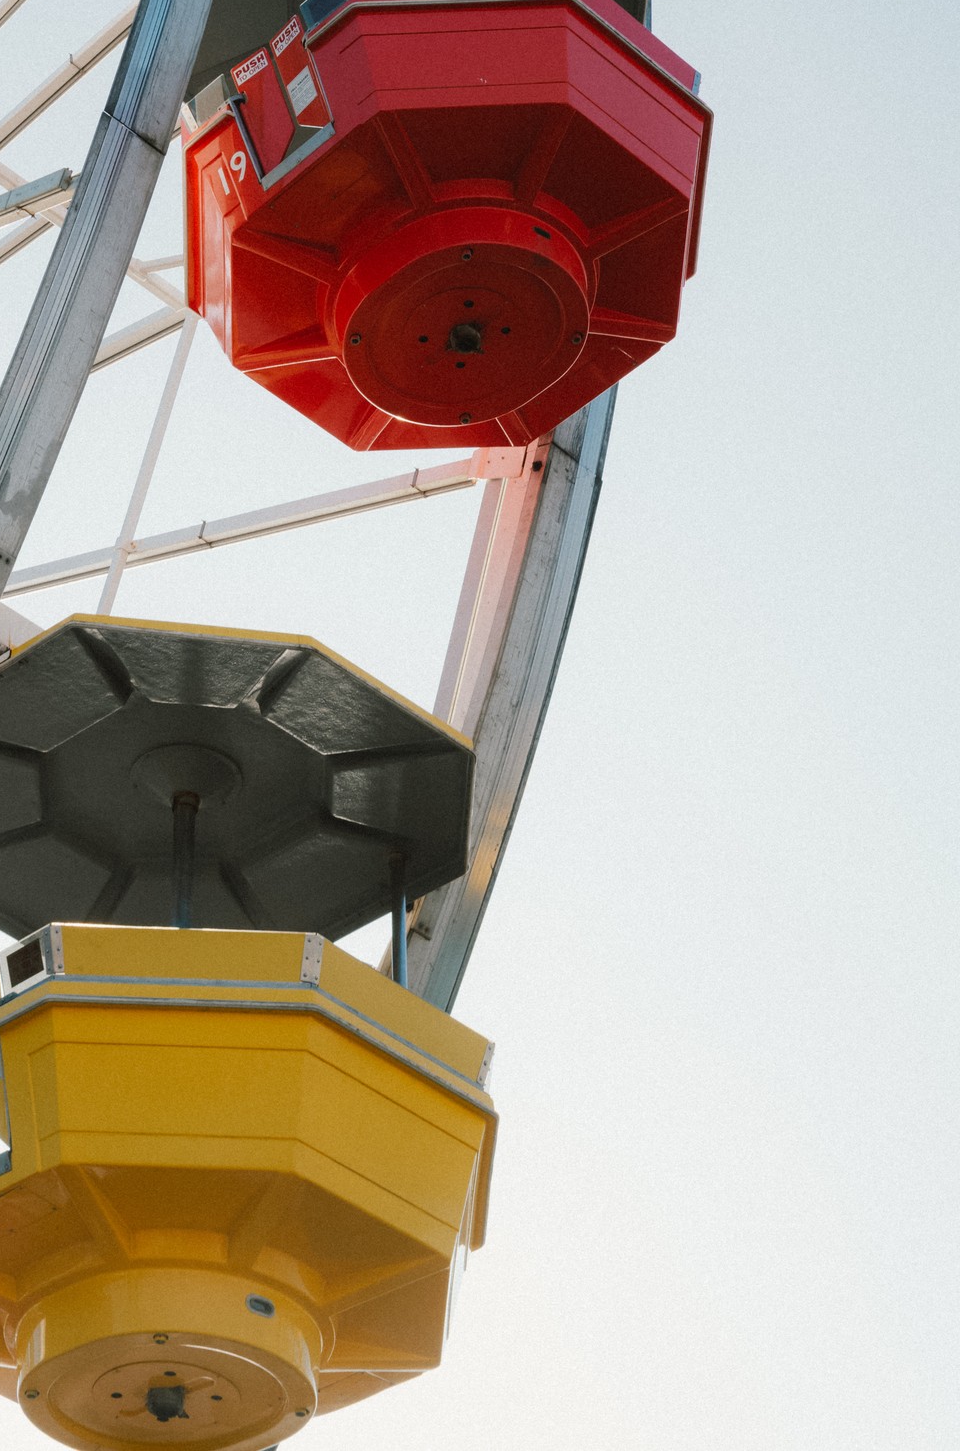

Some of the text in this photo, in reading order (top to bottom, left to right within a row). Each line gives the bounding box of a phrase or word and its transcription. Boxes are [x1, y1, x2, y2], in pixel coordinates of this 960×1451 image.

[273, 21, 297, 49] PUSH
[277, 28, 299, 53] TO OPEN
[235, 53, 265, 79] PUSH
[240, 60, 266, 82] TO OPEN
[217, 150, 247, 196] 19
